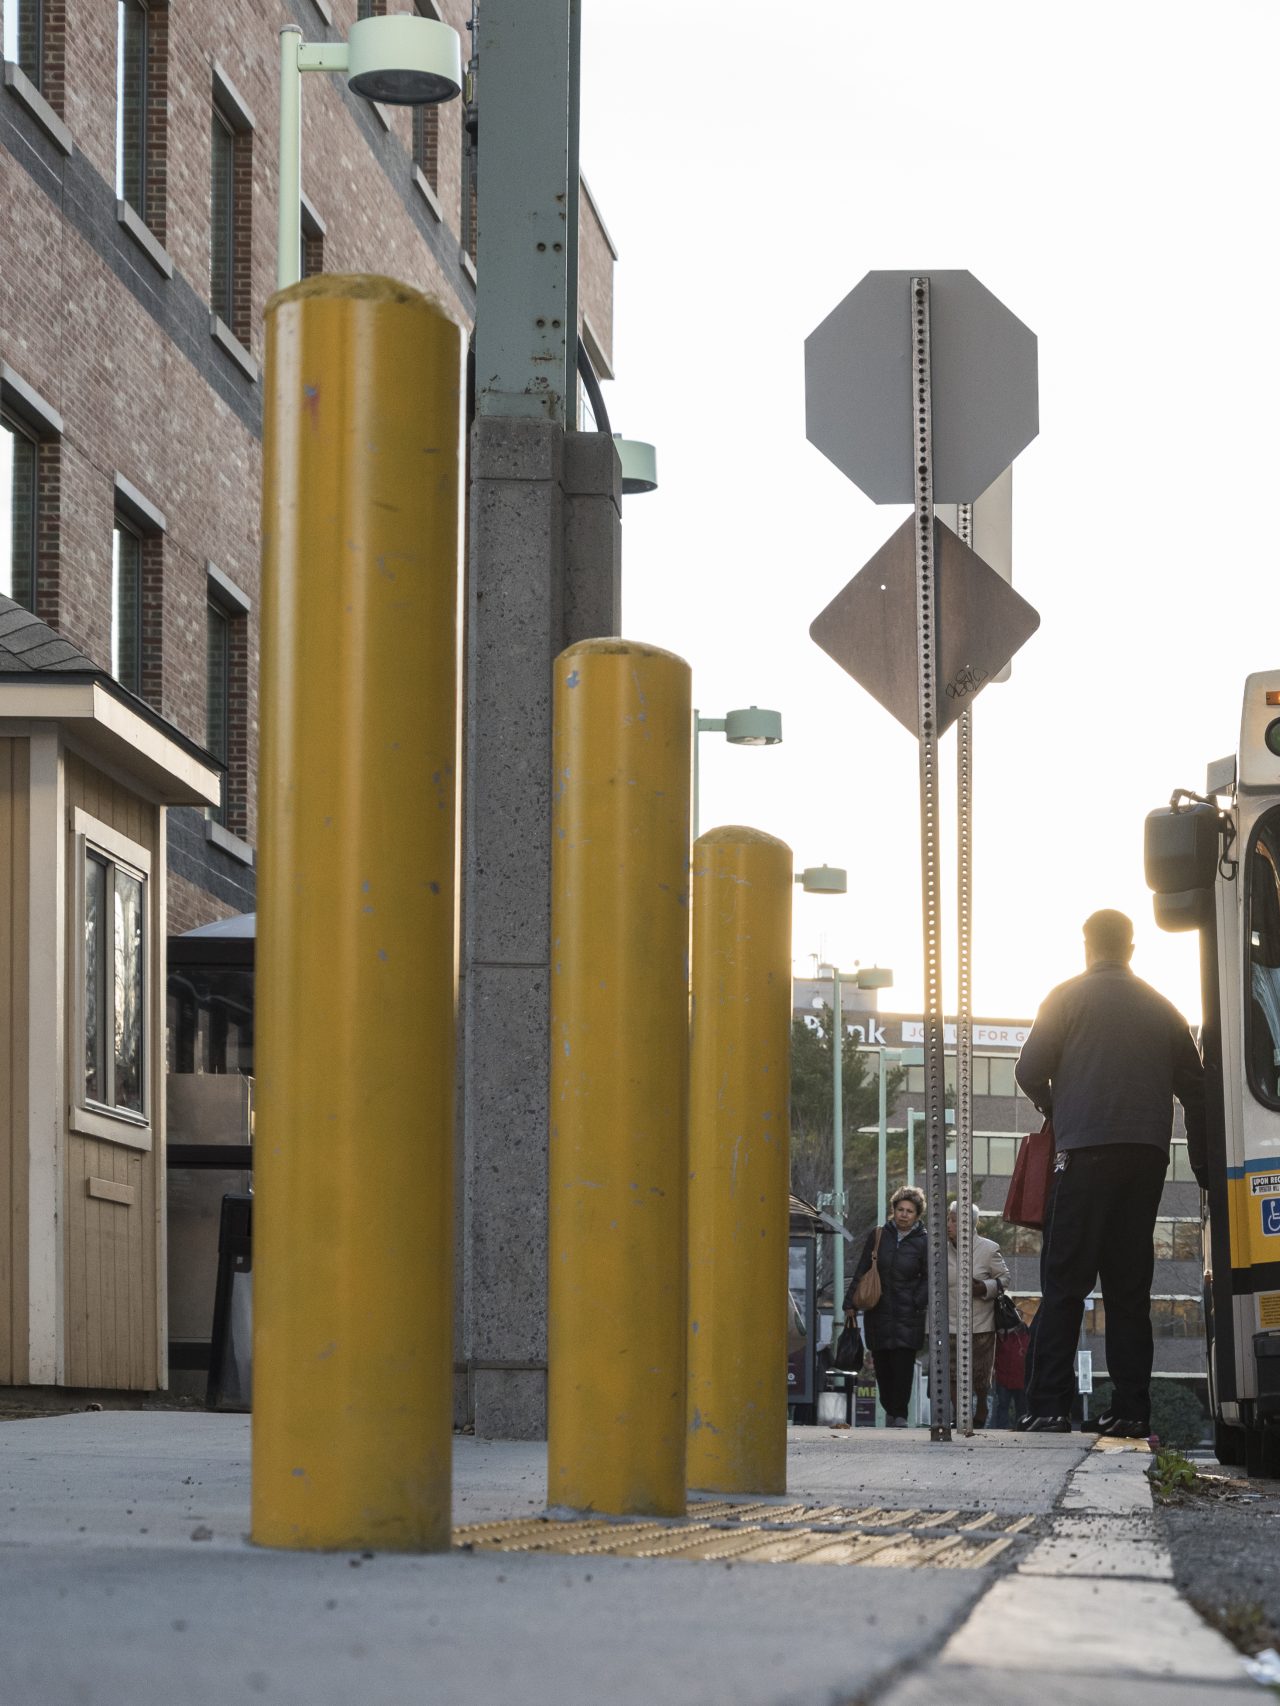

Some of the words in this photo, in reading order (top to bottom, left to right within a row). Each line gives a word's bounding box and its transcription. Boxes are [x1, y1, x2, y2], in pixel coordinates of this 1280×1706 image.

[803, 1015, 886, 1044] Bnk
[978, 1030, 1008, 1041] FOR
[1253, 1177, 1269, 1185] UPON
